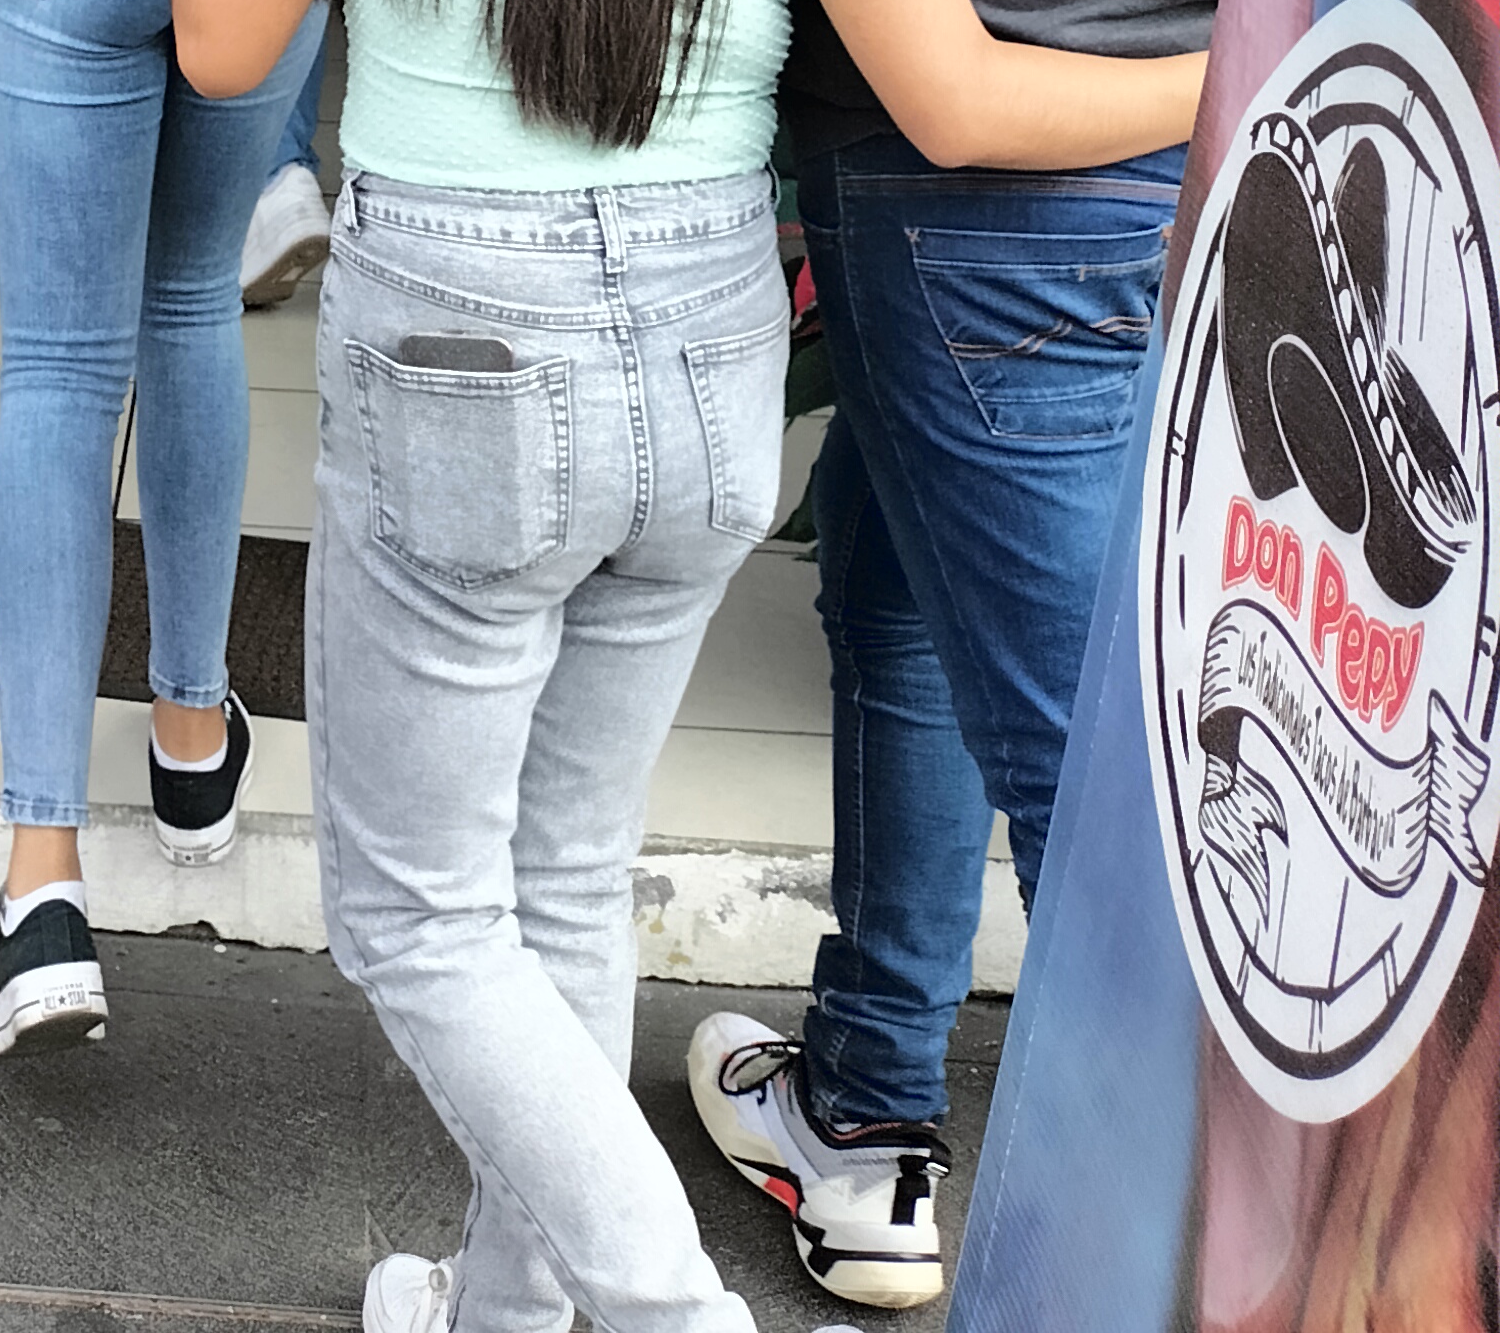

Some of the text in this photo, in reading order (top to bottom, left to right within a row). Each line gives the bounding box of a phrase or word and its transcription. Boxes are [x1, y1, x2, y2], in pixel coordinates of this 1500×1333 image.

[1221, 495, 1425, 733] Don Pepy
[1237, 630, 1258, 688] Los
[1310, 703, 1340, 806] Tacos
[1336, 745, 1350, 825] de
